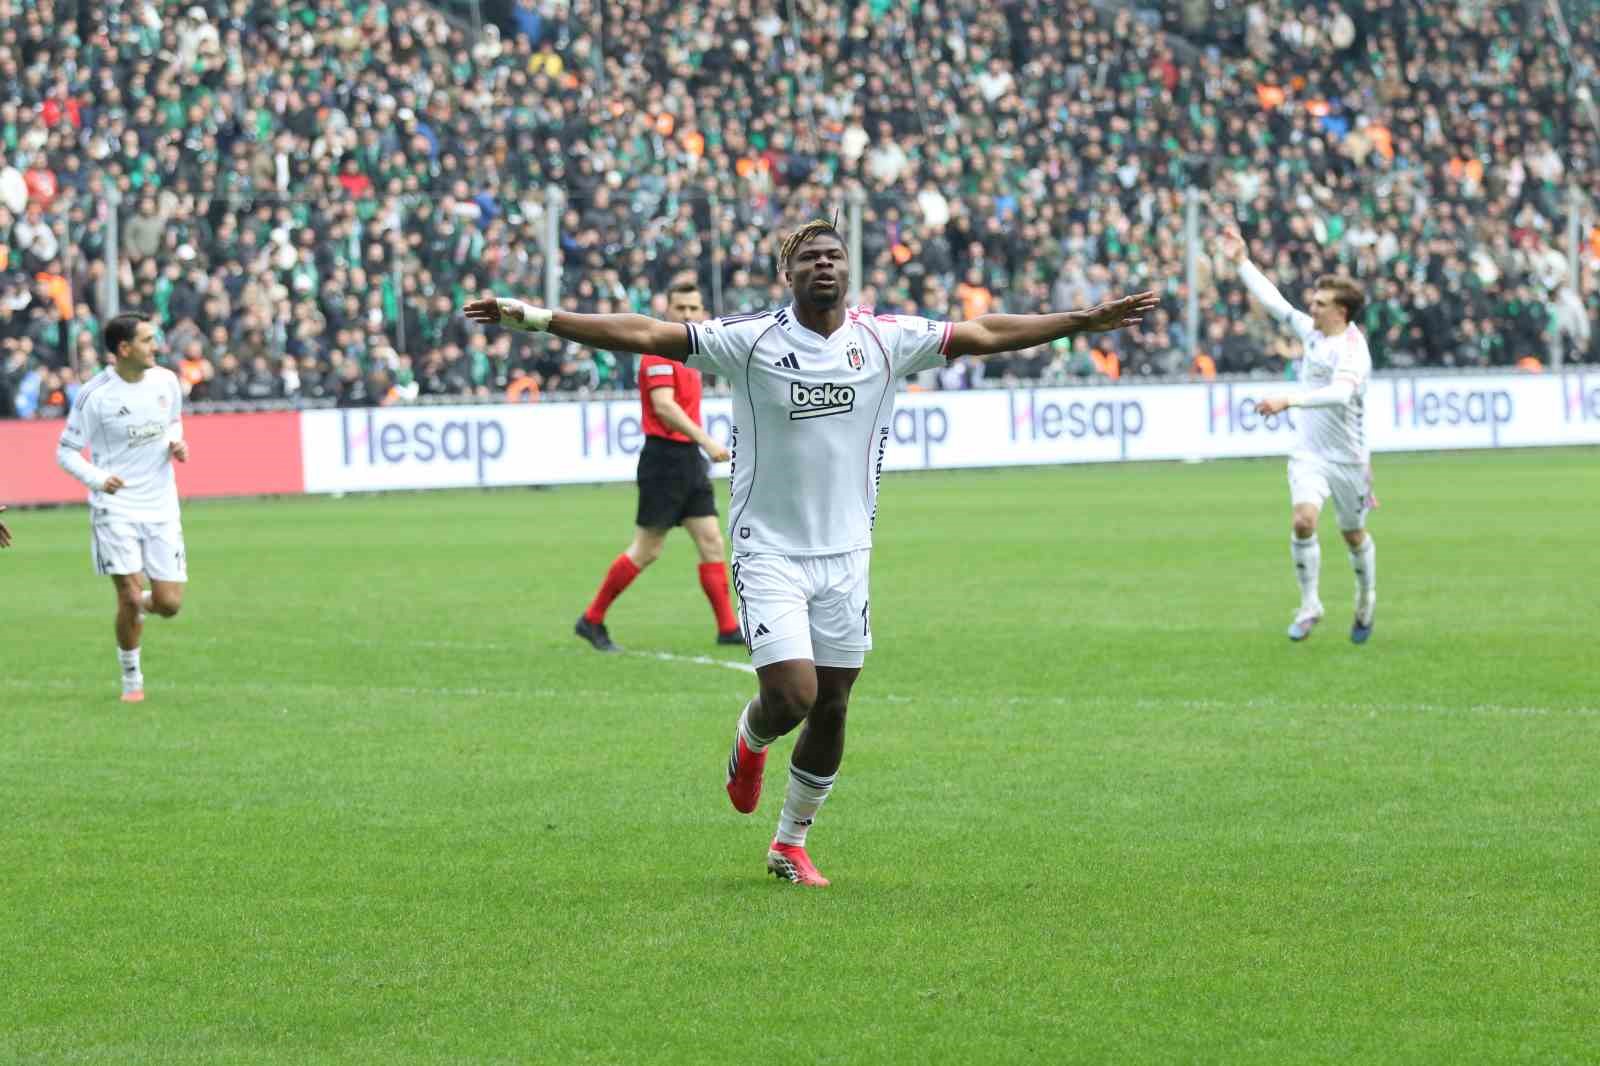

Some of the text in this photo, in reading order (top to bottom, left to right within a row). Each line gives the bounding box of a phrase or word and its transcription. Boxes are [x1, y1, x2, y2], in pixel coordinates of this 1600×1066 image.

[791, 382, 855, 406] beko
[1008, 387, 1144, 459] Hesap
[1394, 376, 1512, 447] Hesap
[341, 407, 505, 485] Hesap
